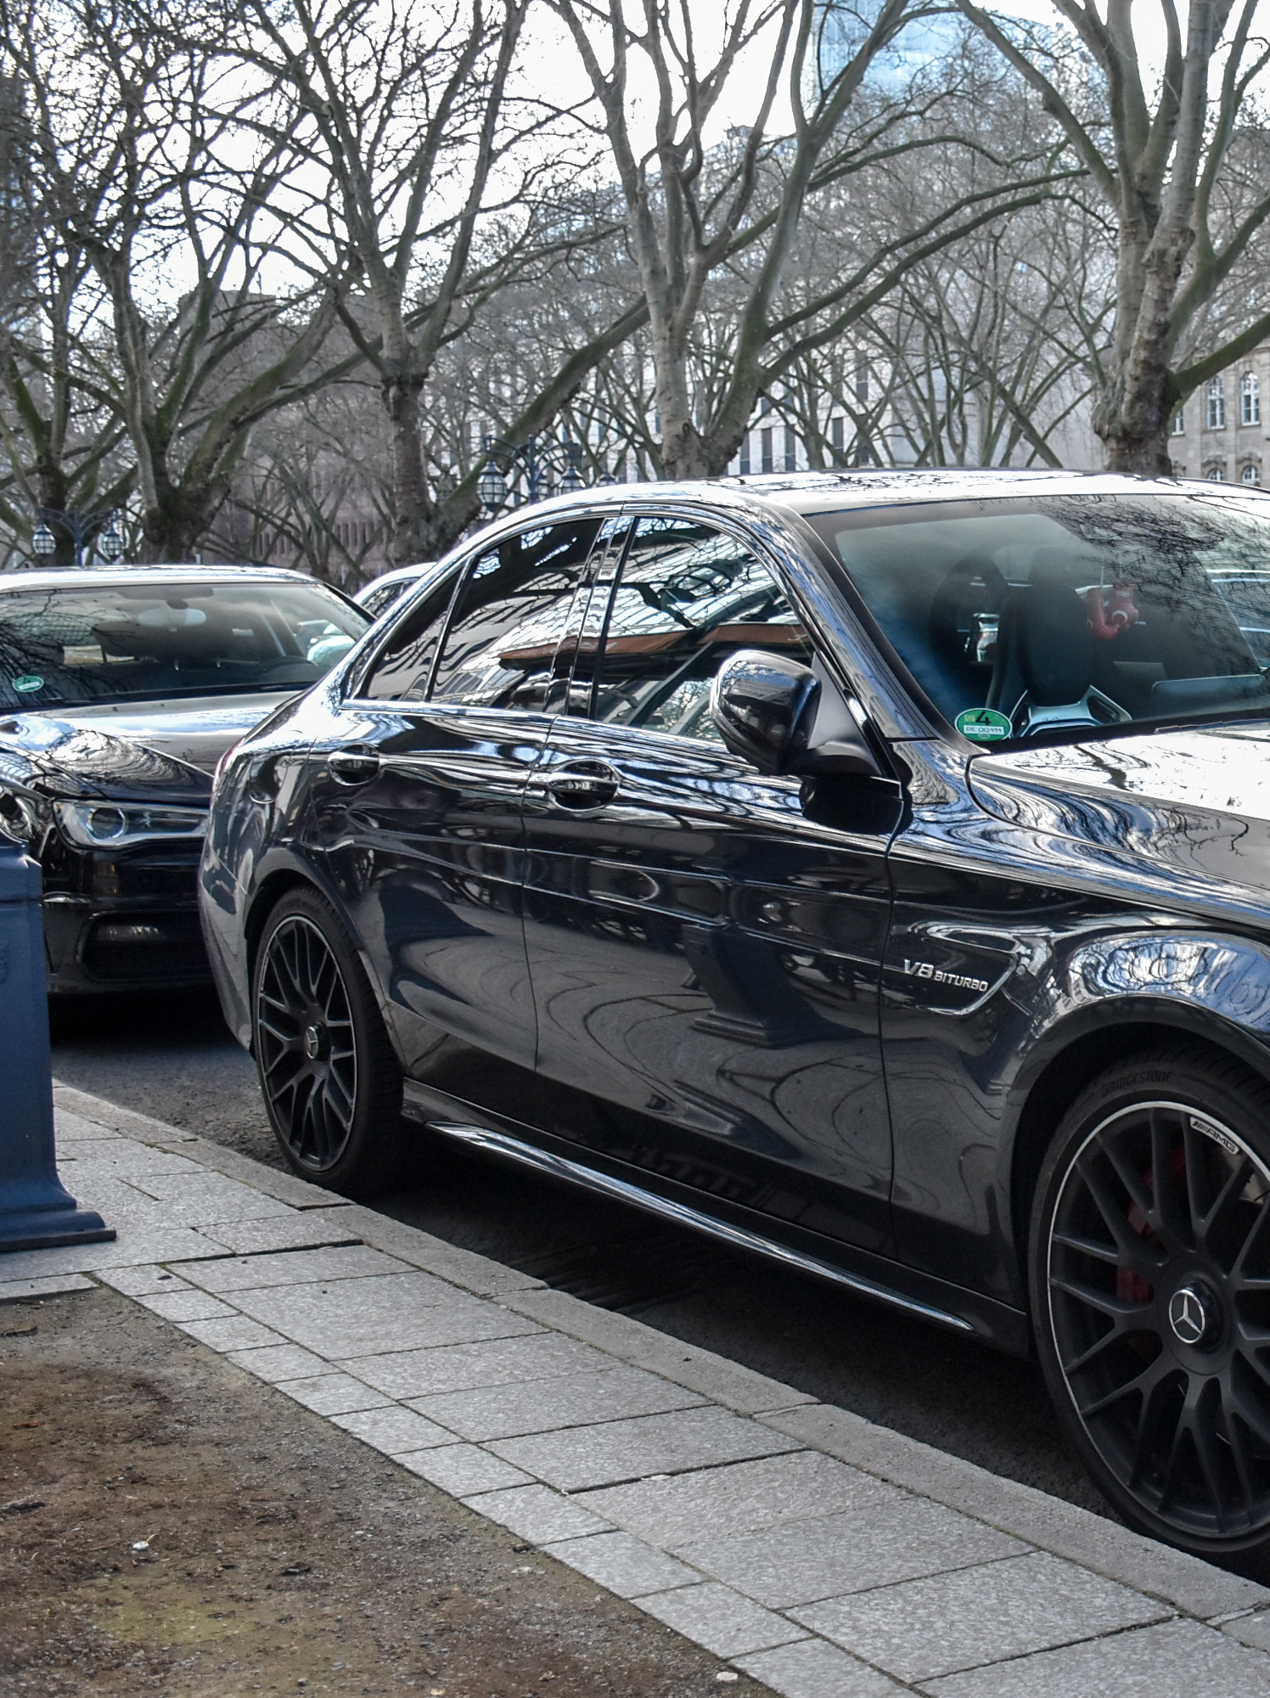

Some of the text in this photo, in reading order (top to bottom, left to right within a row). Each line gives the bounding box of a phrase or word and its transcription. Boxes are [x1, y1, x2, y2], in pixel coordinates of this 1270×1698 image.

[976, 710, 991, 725] 4
[904, 959, 989, 992] V8 BITURBO
[1206, 1128, 1236, 1153] AMG
